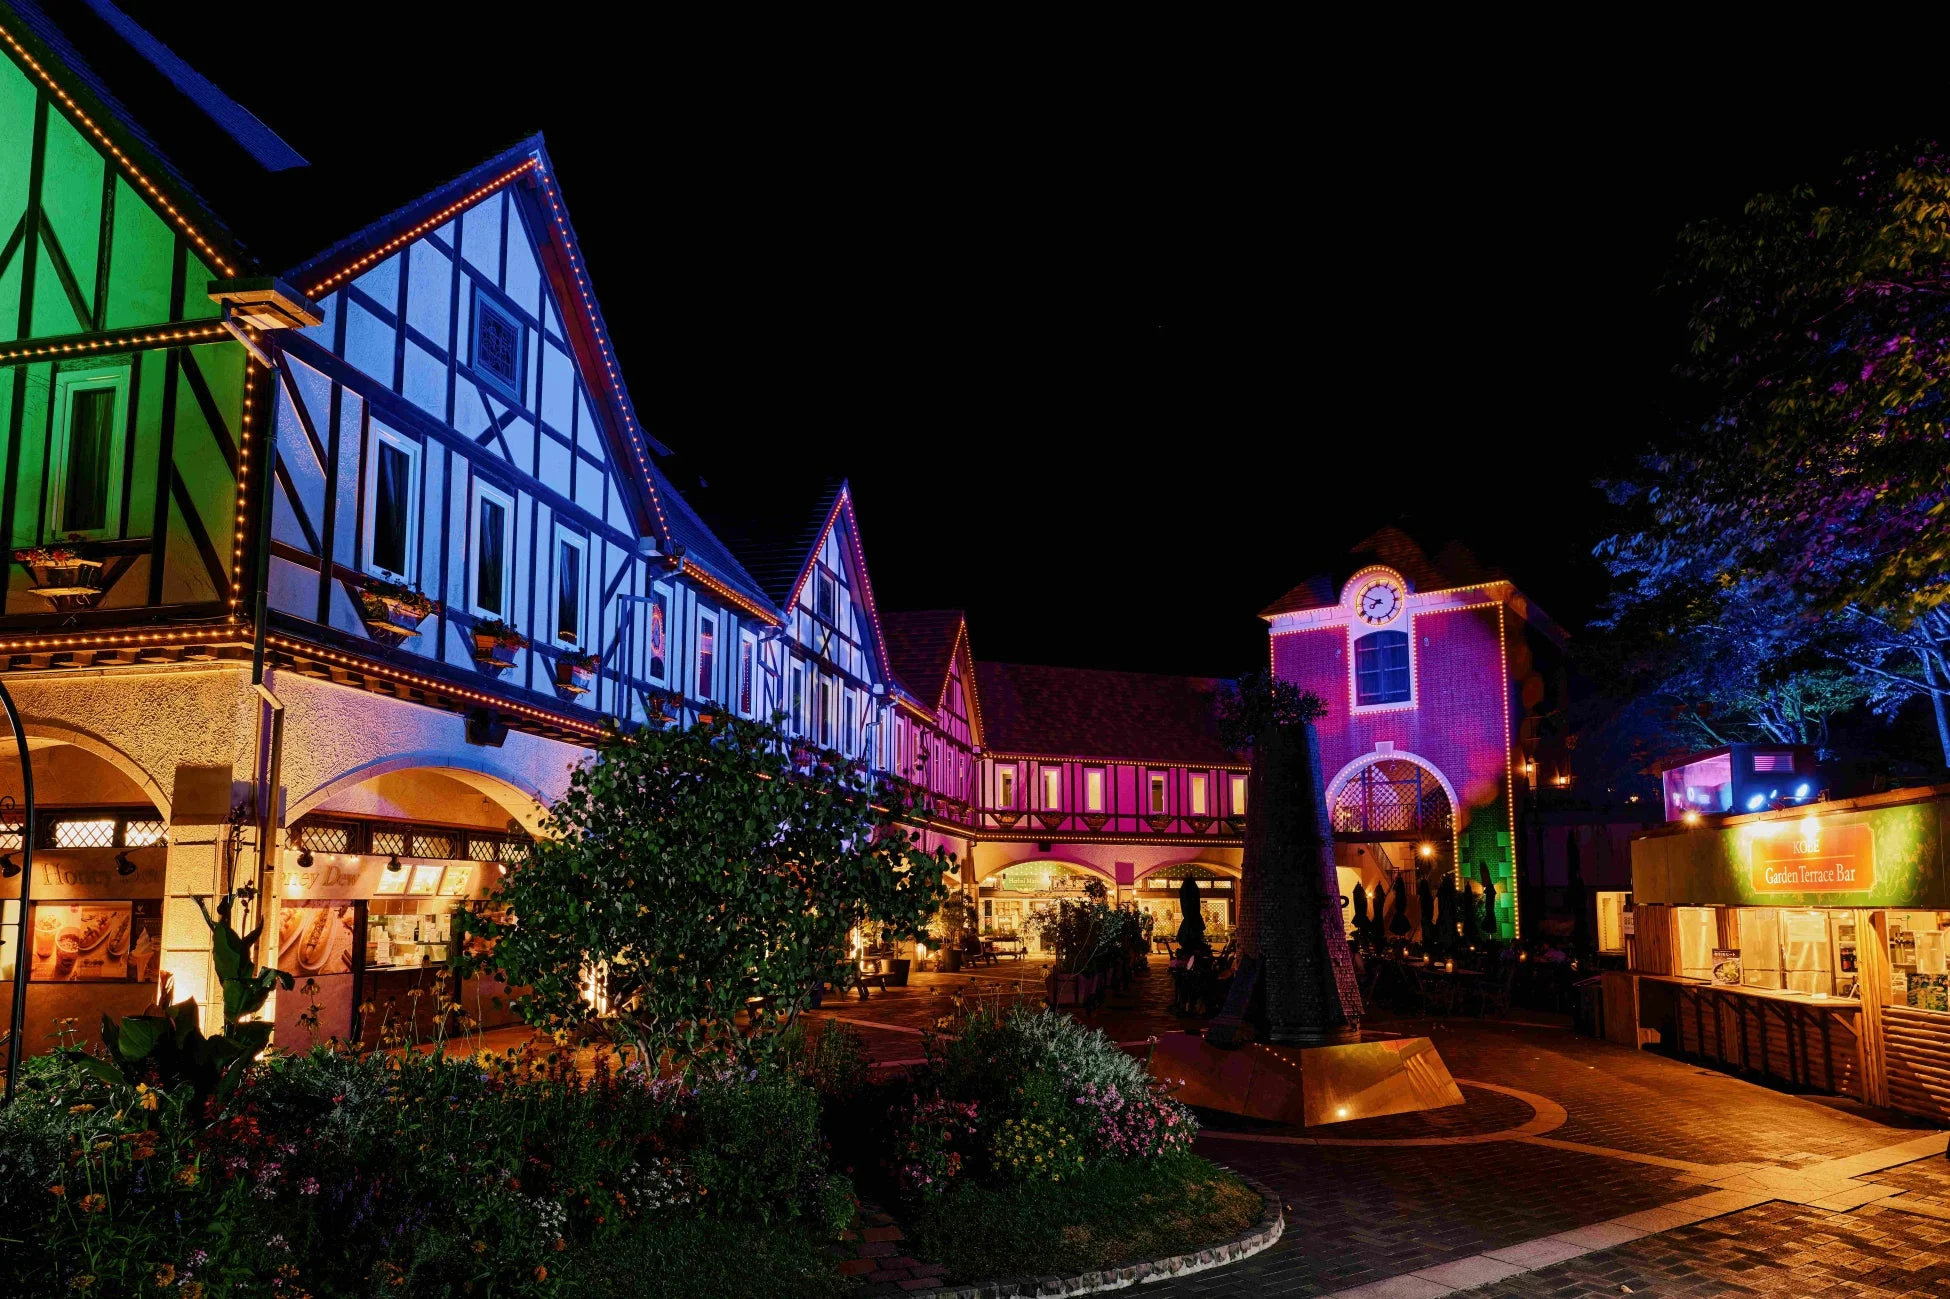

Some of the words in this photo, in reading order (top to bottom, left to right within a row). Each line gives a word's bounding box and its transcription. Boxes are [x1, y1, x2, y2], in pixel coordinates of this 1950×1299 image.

[1793, 840, 1820, 854] KOBE
[1765, 866, 1799, 884] Garden
[1798, 865, 1834, 883] Terrace
[1835, 863, 1856, 882] Bar
